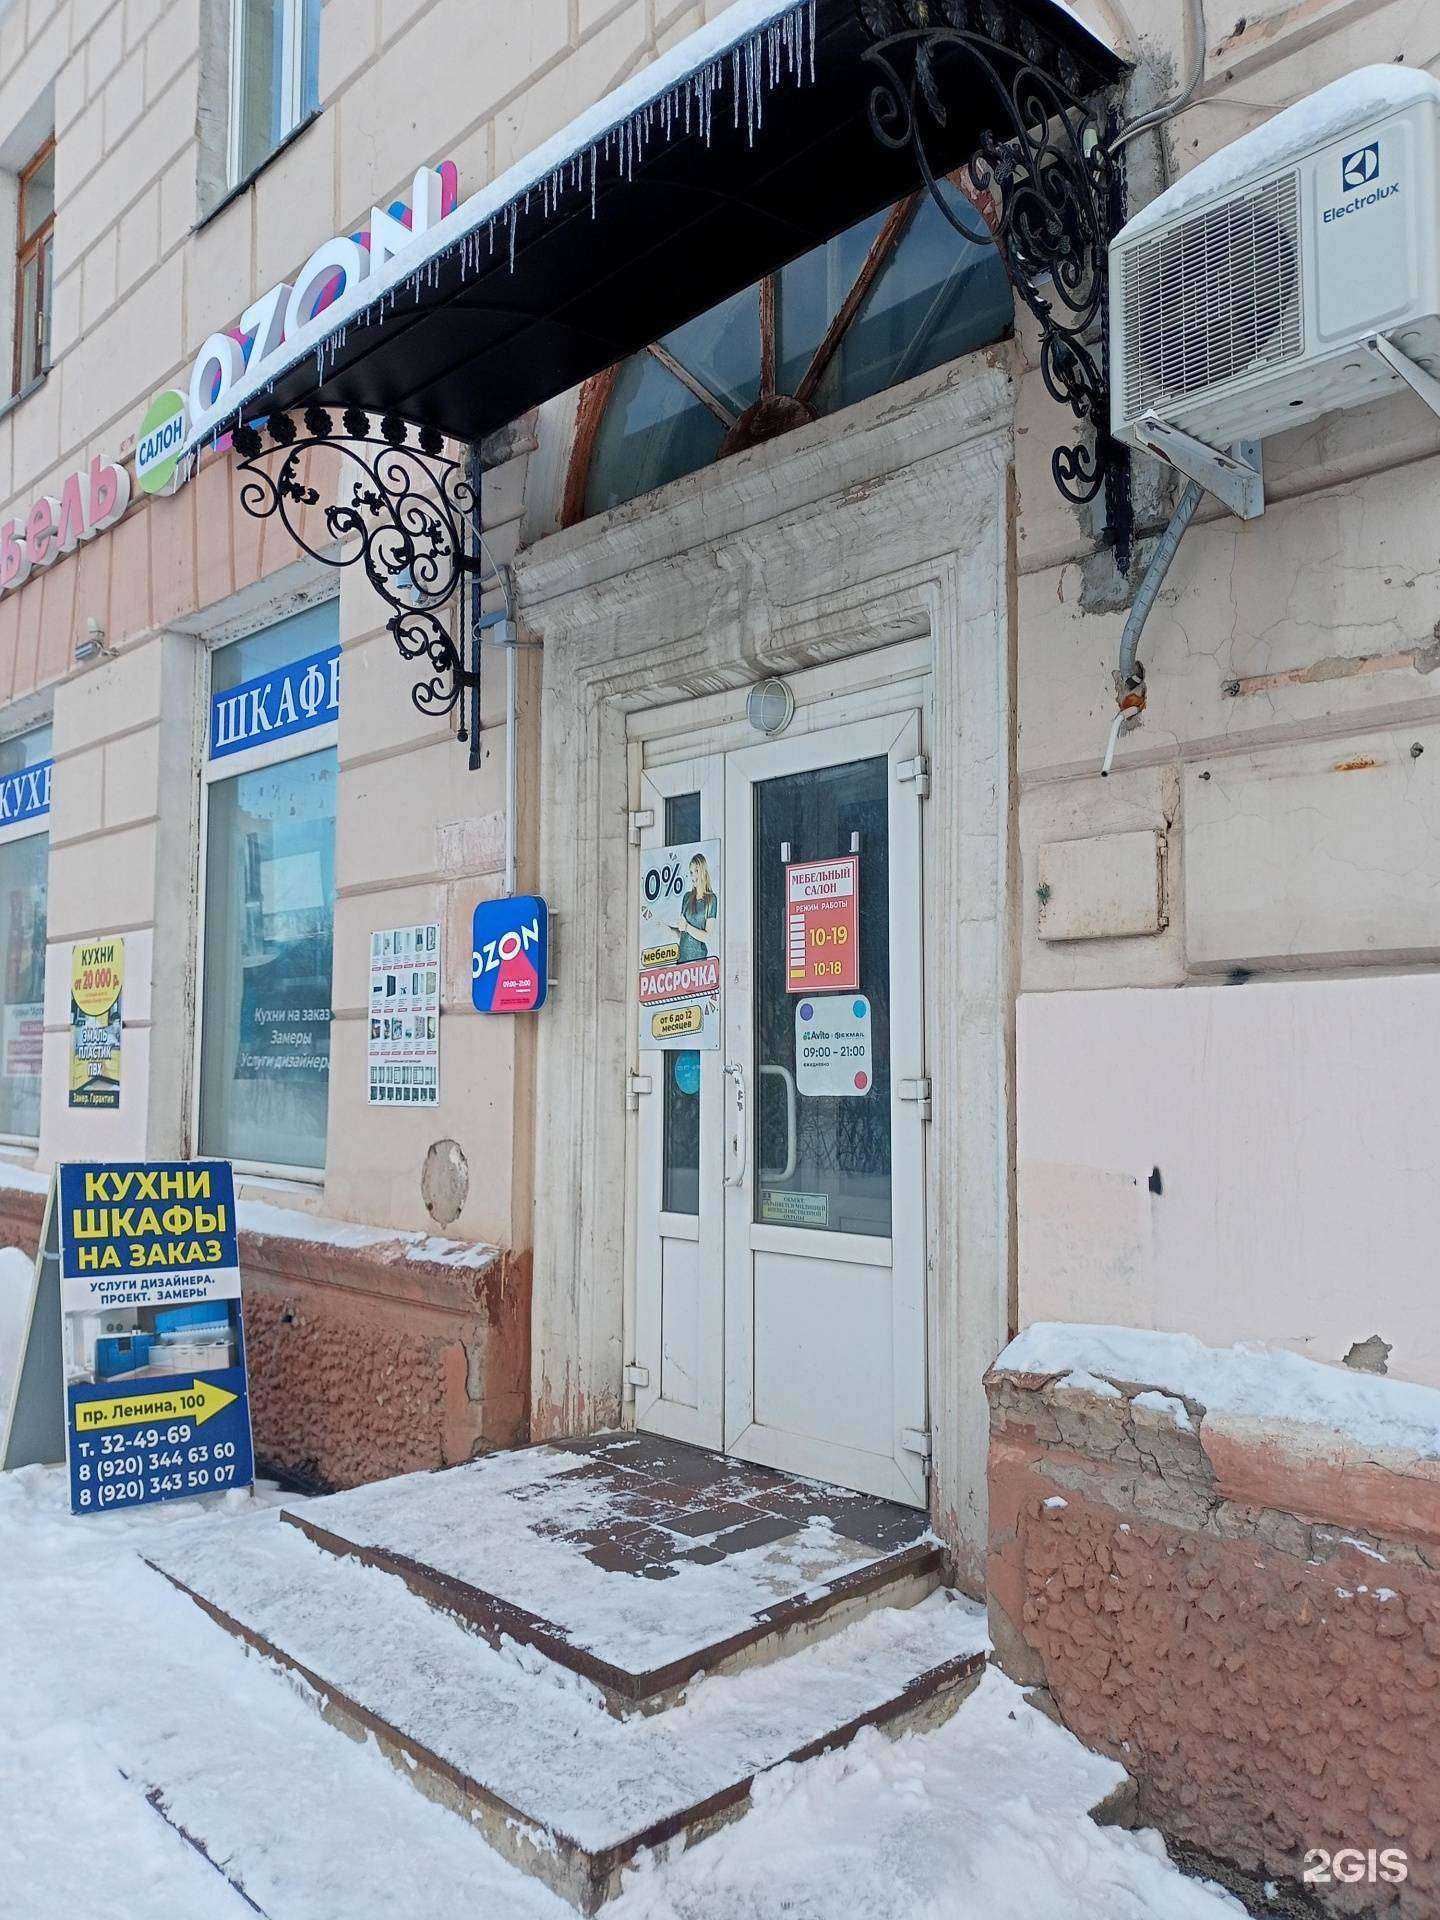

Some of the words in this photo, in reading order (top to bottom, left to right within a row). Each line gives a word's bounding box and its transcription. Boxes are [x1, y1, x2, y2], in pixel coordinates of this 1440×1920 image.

[1323, 182, 1399, 223] Electrolux
[189, 163, 445, 425] OZON
[139, 416, 182, 466] САЛОН
[645, 863, 683, 901] 0%
[792, 867, 850, 885] МЕБЕЛЬНЫЙ
[804, 883, 837, 896] САЛОН
[796, 904, 819, 913] РЕЖИМ
[821, 900, 848, 910] РАБОТЫ
[809, 926, 848, 946] 10-19
[82, 945, 114, 966] КУХНИ
[472, 918, 539, 979] OZON
[643, 948, 678, 963] мебель
[813, 961, 842, 976] 10-18
[74, 982, 81, 991] от
[83, 970, 93, 989] 20
[640, 964, 717, 996] РАССРОЧКА
[254, 1008, 286, 1025] Кухни
[287, 1010, 300, 1021] на
[302, 1009, 330, 1021] заказ
[660, 1016, 668, 1025] от
[669, 1014, 674, 1023] 6
[675, 1013, 684, 1023] до
[685, 1010, 692, 1020] 12
[662, 1021, 692, 1032] месяцев
[811, 1031, 830, 1040] Avito
[82, 1028, 108, 1045] ЭМАЛЬ
[270, 1030, 312, 1047] Замеры
[78, 1045, 112, 1060] ПЛАСТИК
[803, 1047, 831, 1058] 09:00
[840, 1046, 865, 1057] 21:00
[88, 1062, 103, 1077] ПВХ
[240, 1053, 272, 1070] Услуги
[85, 1171, 211, 1202] КУХНИ
[73, 1205, 226, 1238] ШКАФЫ
[78, 1245, 122, 1270] НА
[129, 1240, 222, 1268] ЗАКАЗ
[90, 1280, 137, 1292] УСЛУГИ
[140, 1275, 215, 1290] ДИЗАЙНЕРА.
[101, 1292, 150, 1305] ПРОЕКТ.
[157, 1288, 207, 1300] ЗАМЕРЫ
[83, 1411, 107, 1424] пр.
[112, 1402, 177, 1419] Ленина,
[180, 1394, 205, 1410] 100
[79, 1443, 94, 1457] т.
[101, 1424, 191, 1455] 32-49-69
[79, 1464, 91, 1481] 8
[97, 1455, 143, 1482] (920)
[149, 1450, 183, 1470] 344
[188, 1445, 209, 1463] 63
[214, 1442, 235, 1459] 60
[79, 1489, 91, 1506] 8
[98, 1479, 144, 1507] (920)
[150, 1474, 182, 1493] 343
[188, 1471, 209, 1487] 50
[214, 1465, 235, 1482] 07
